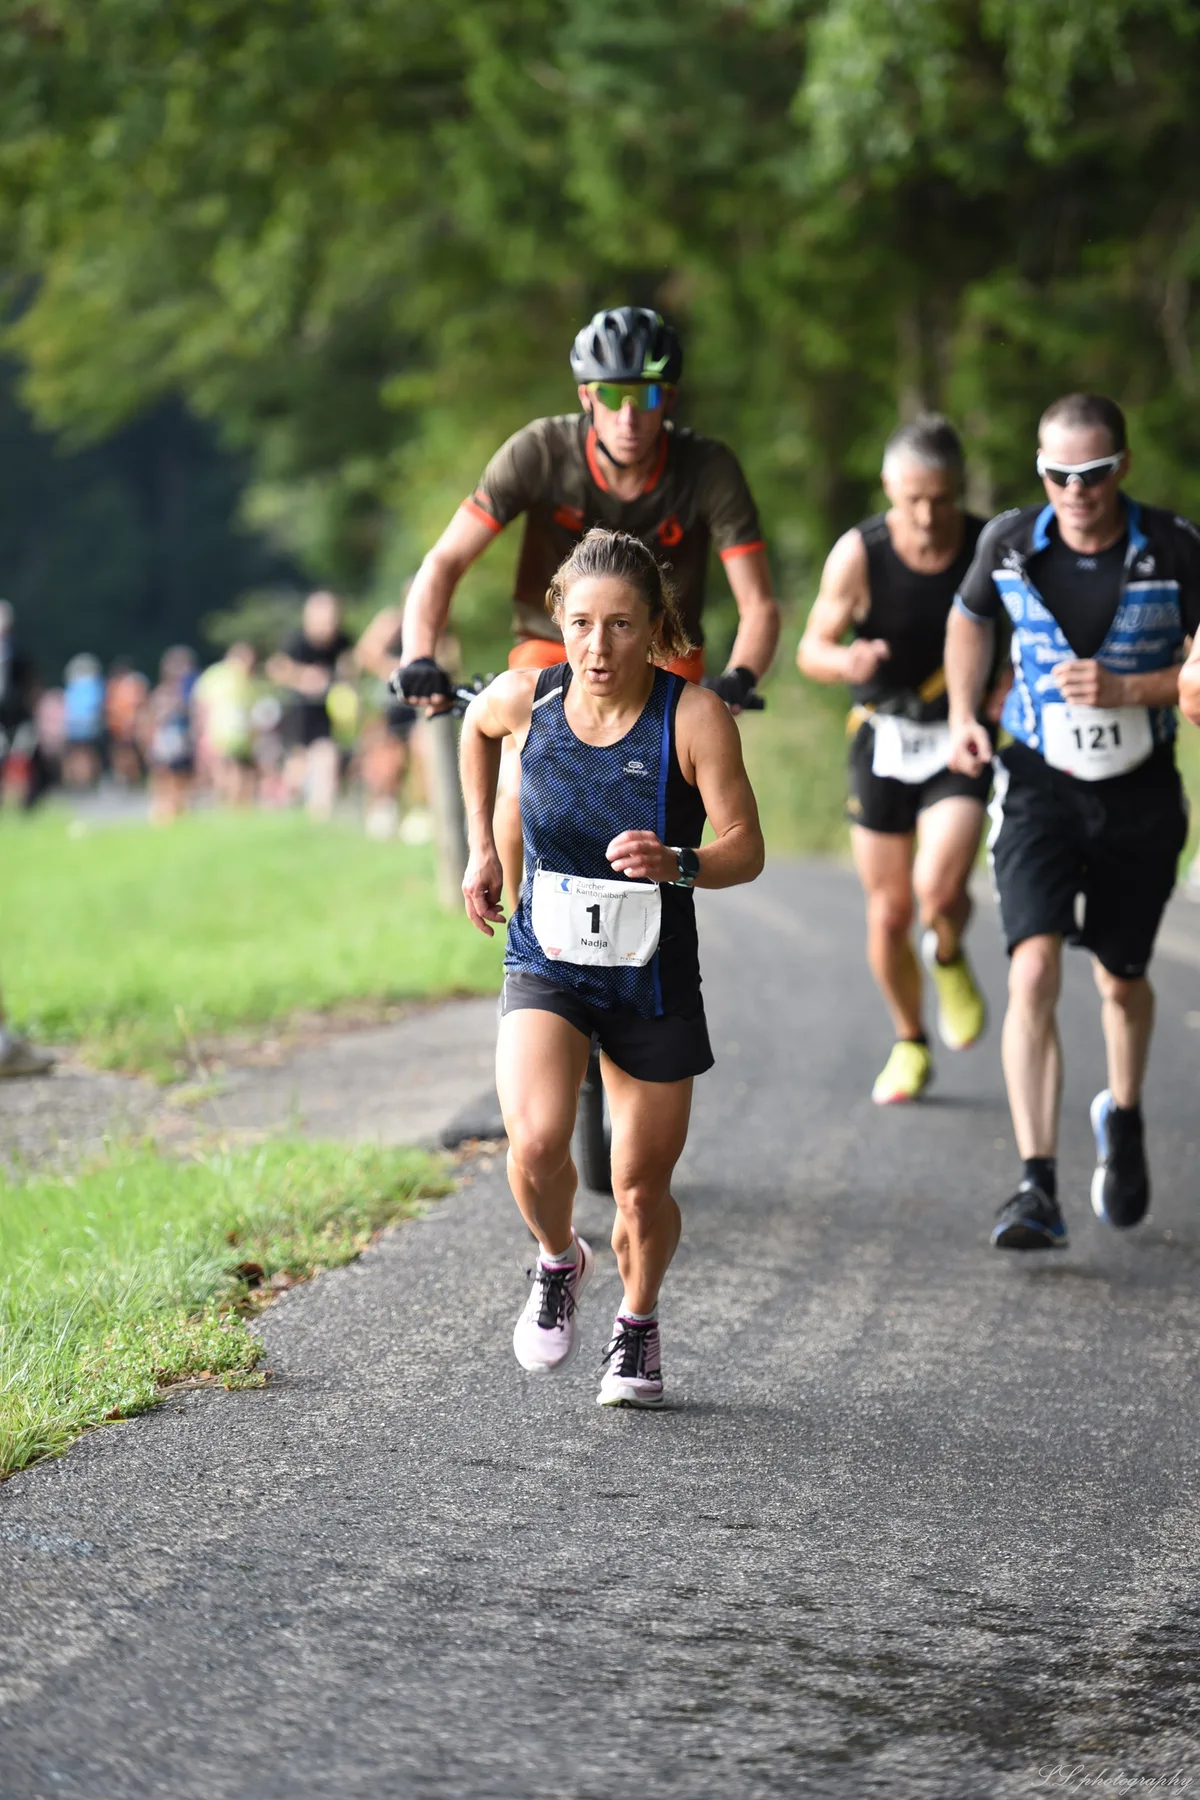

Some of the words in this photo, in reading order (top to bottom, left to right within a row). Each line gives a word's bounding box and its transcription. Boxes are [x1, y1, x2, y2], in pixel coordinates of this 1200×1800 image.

[1072, 723, 1121, 749] 121
[576, 887, 628, 899] Kantonalbank
[586, 903, 600, 934] 1
[580, 938, 608, 949] Nadja
